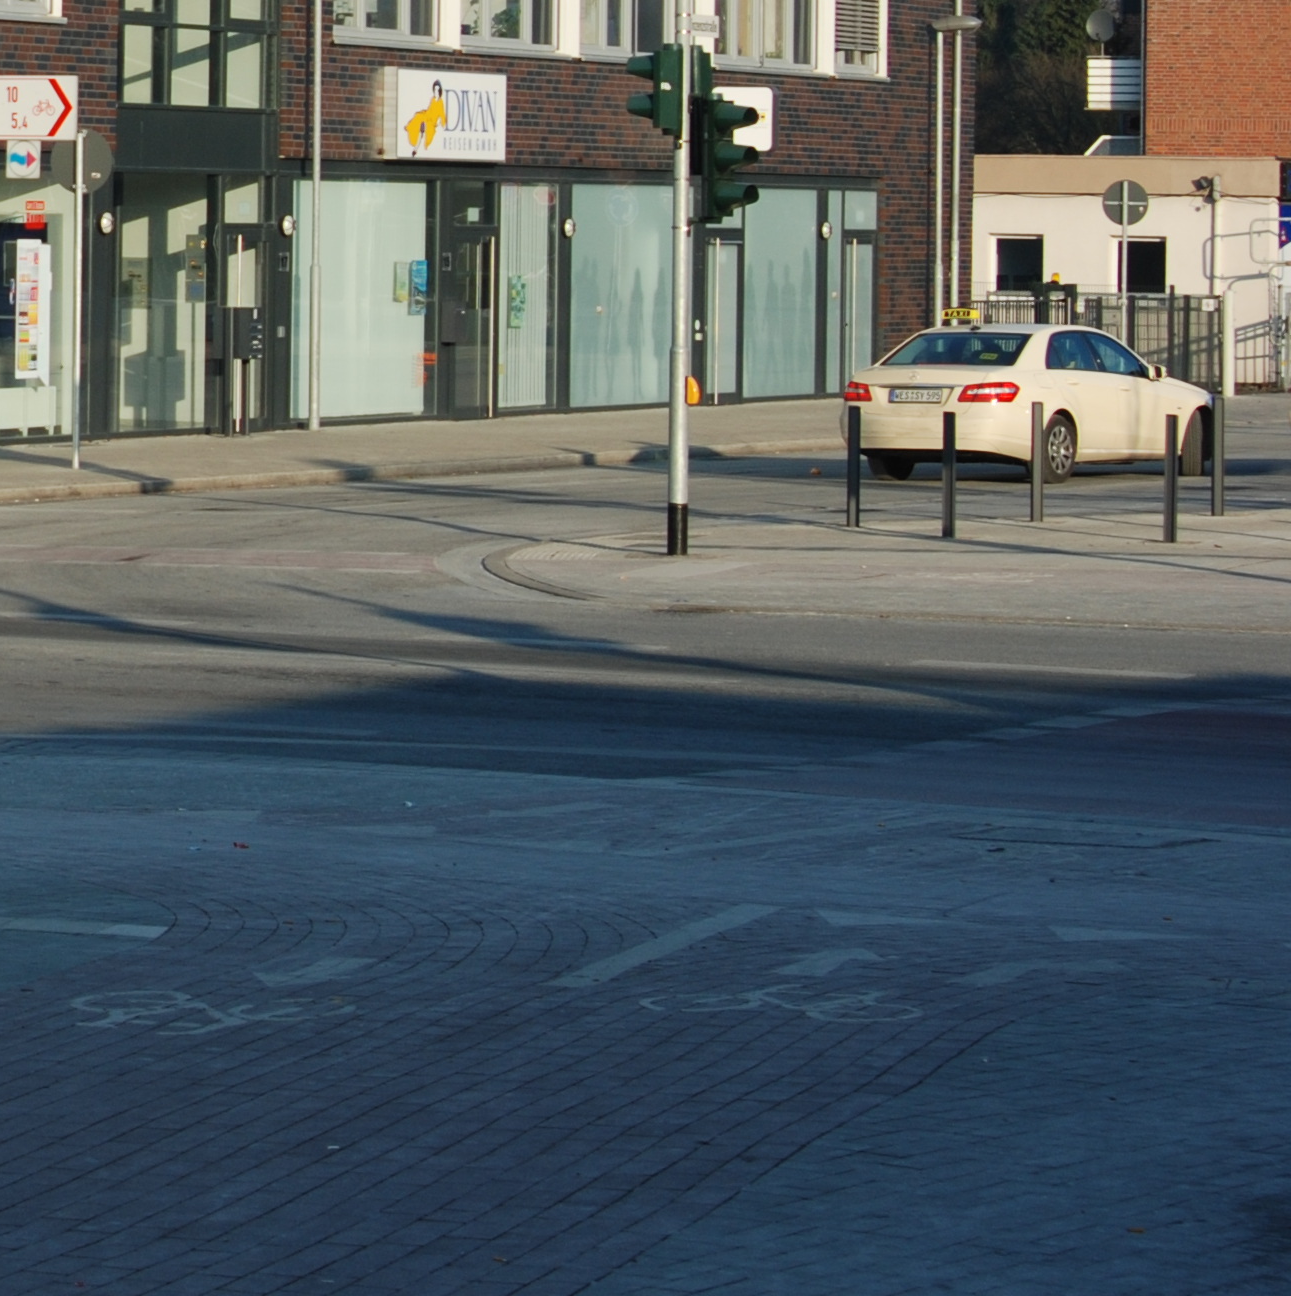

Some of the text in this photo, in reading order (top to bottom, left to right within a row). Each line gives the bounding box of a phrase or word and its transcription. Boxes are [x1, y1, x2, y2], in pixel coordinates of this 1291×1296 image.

[6, 86, 18, 103] 10
[444, 89, 498, 133] DIVAN
[944, 310, 971, 318] TAXI
